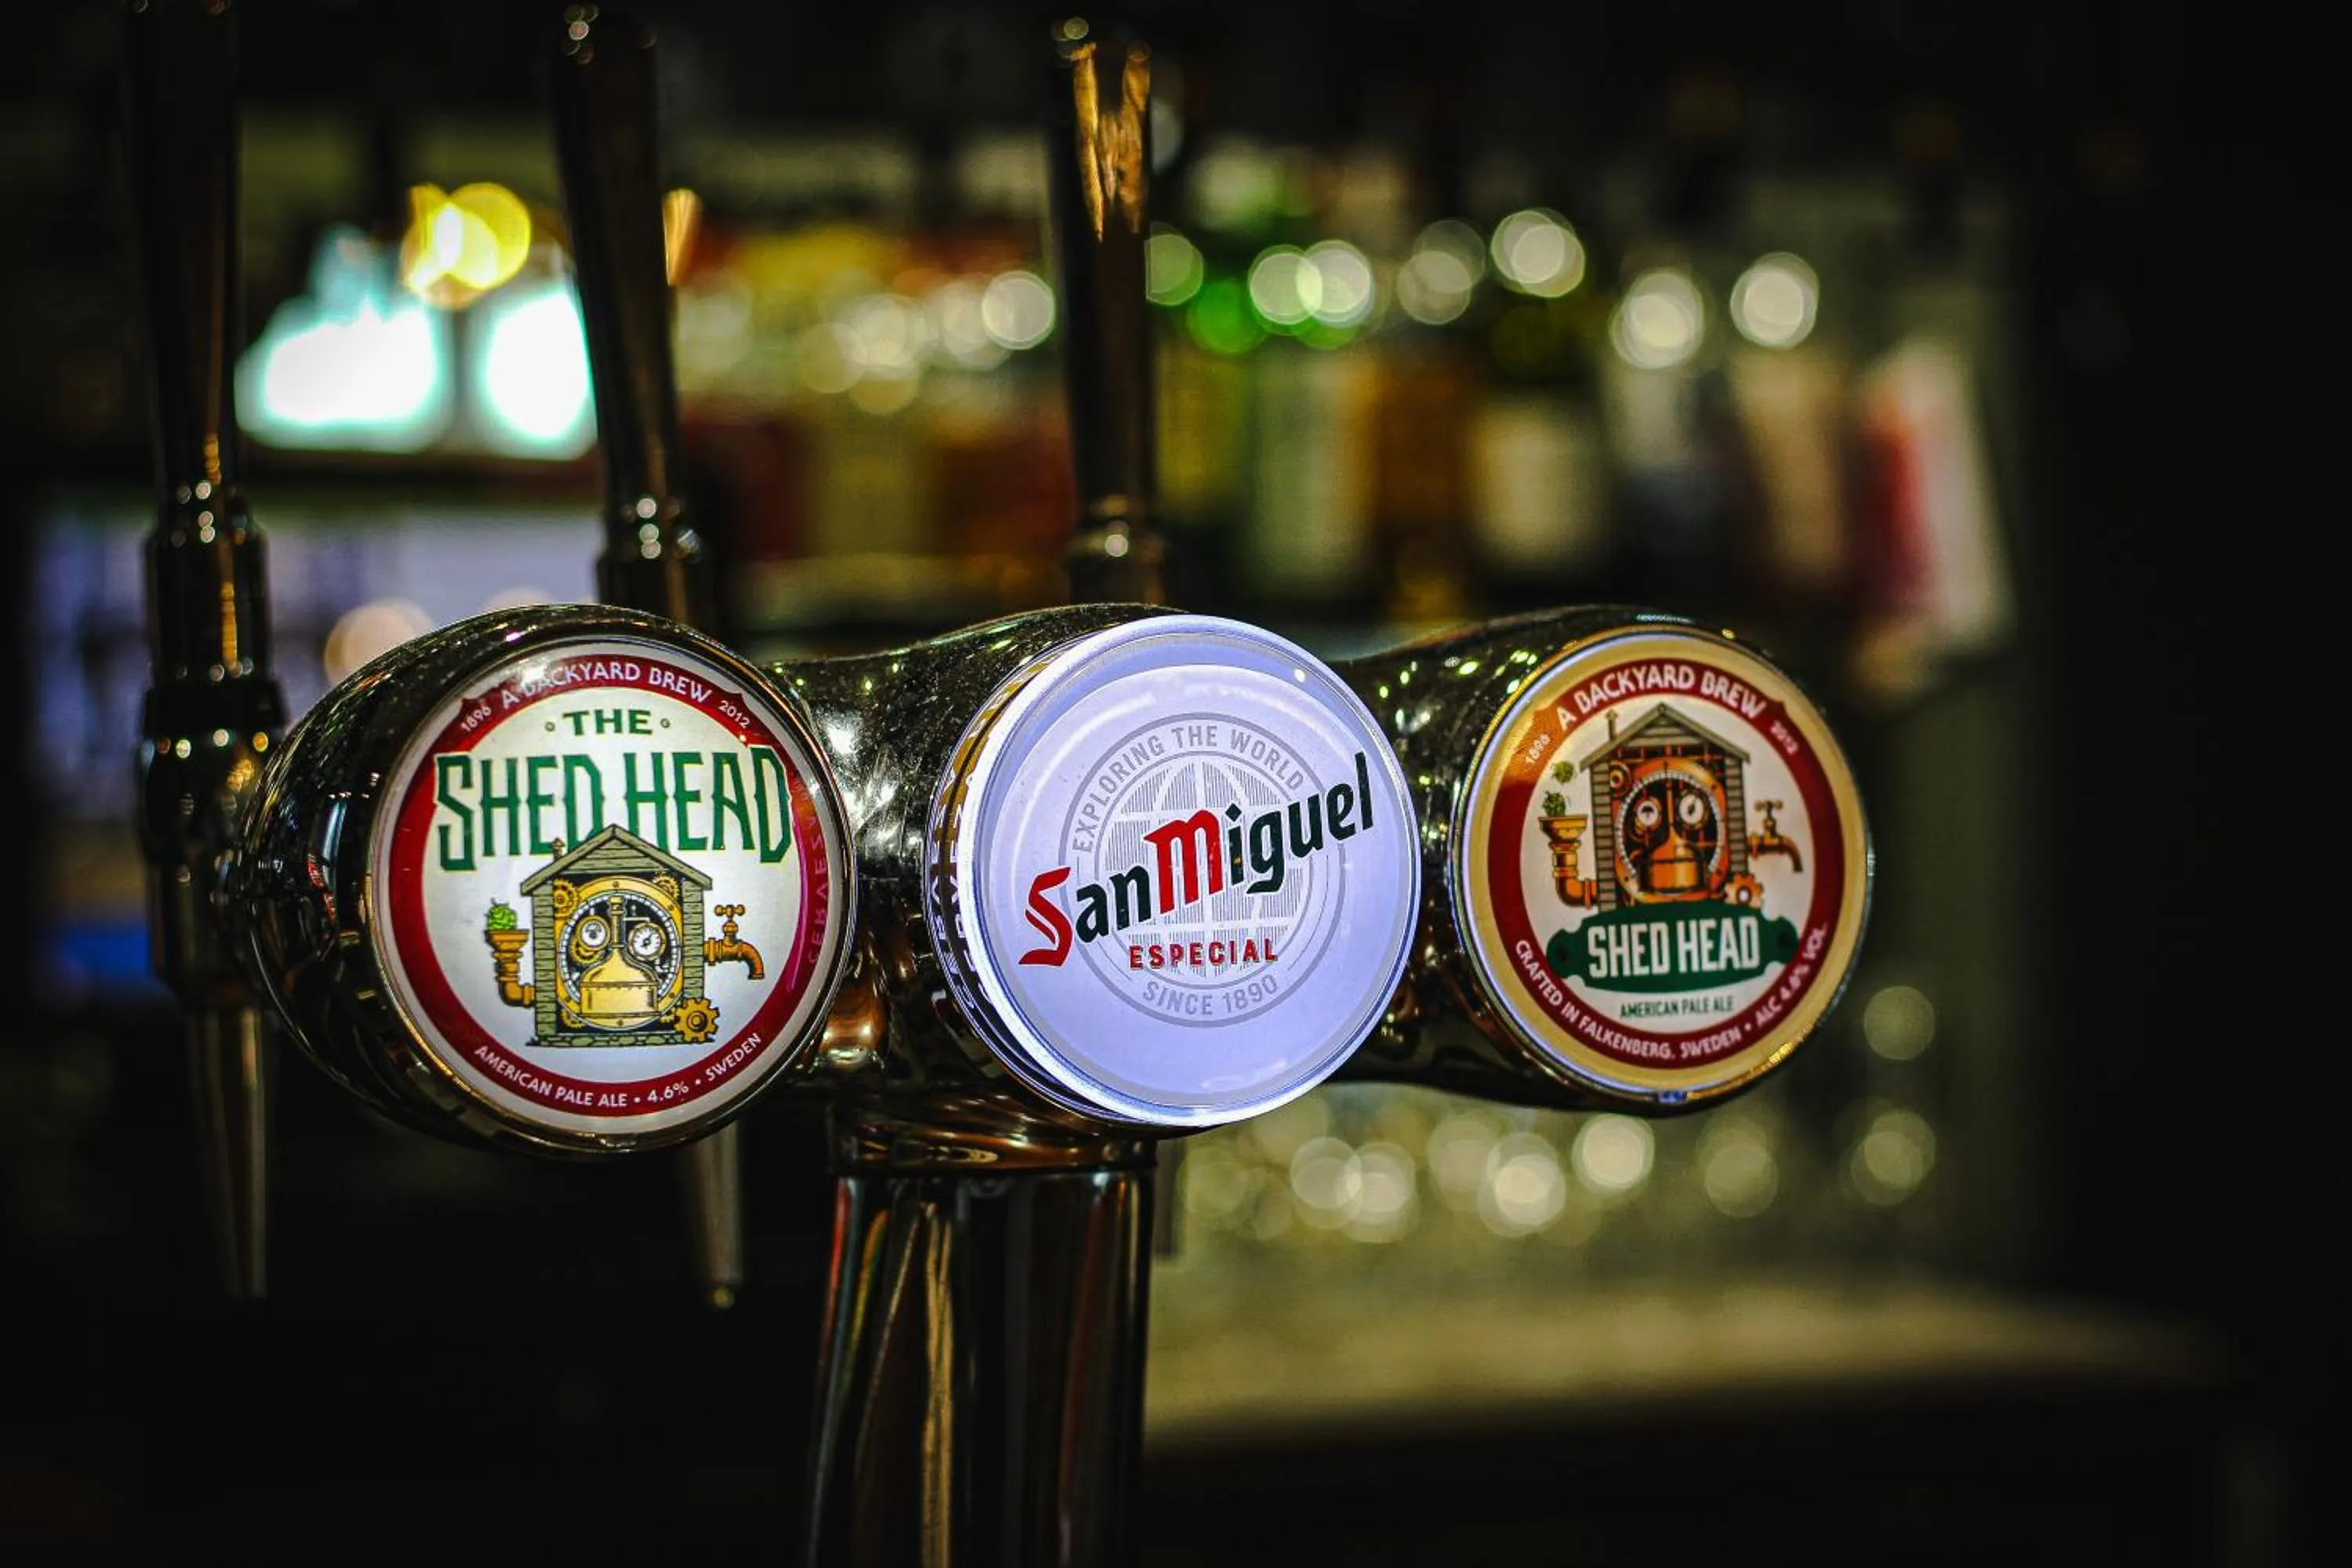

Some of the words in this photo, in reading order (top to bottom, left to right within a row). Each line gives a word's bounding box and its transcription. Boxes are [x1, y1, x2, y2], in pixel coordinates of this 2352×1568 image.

[459, 702, 492, 731] 1896
[500, 690, 520, 709] A
[648, 668, 713, 702] BREW
[718, 700, 750, 728] 2012
[563, 710, 653, 735] THE
[1556, 706, 1577, 731] A
[1573, 665, 1696, 714] BACKYARD
[1700, 670, 1767, 718] BREW
[436, 753, 604, 871] SHED
[624, 746, 793, 863] HEAD
[1073, 735, 1164, 854] EXPLORING
[1171, 725, 1218, 749] THE
[1230, 728, 1305, 791] WORLD
[1130, 938, 1278, 969] ESPECIAL
[1588, 922, 1670, 978] SHED
[1676, 916, 1760, 973] HEAD
[1143, 981, 1213, 1015] SINCE
[1222, 974, 1279, 1013] 1890
[1515, 940, 1563, 1006] CRAFTED
[1561, 1002, 1580, 1023] IN
[1680, 1026, 1742, 1058] SWEDEN
[1620, 1000, 1679, 1018] AMERICAN
[1682, 997, 1709, 1015] PALE
[1714, 996, 1734, 1011] ALE
[474, 1046, 552, 1096] AMERICAN
[555, 1086, 594, 1105] PALE
[598, 1094, 627, 1107] ALE
[647, 1082, 689, 1102] 4.6%
[706, 1033, 762, 1081] SWEDEN
